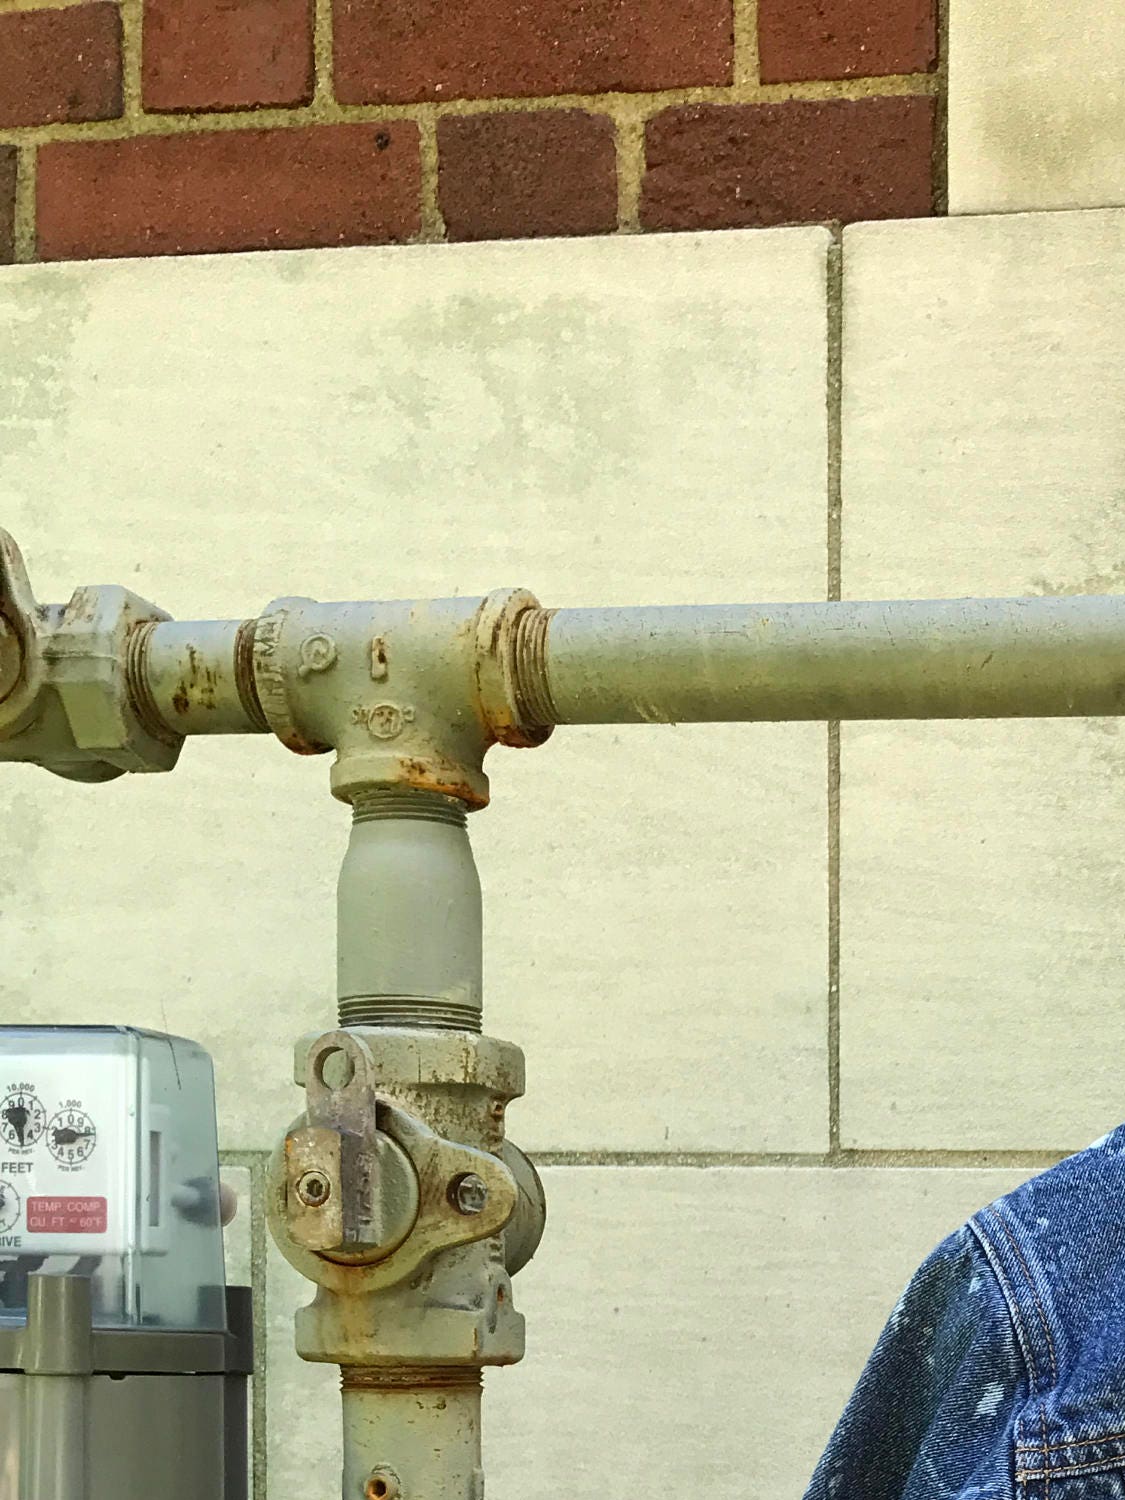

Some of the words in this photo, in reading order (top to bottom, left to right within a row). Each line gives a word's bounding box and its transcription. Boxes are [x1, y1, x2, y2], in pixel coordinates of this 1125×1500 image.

[1, 1162, 34, 1173] FEET
[31, 1201, 62, 1212] TEMP
[67, 1201, 101, 1212] COMP
[30, 1217, 46, 1227] CU
[0, 1236, 22, 1247] IVE
